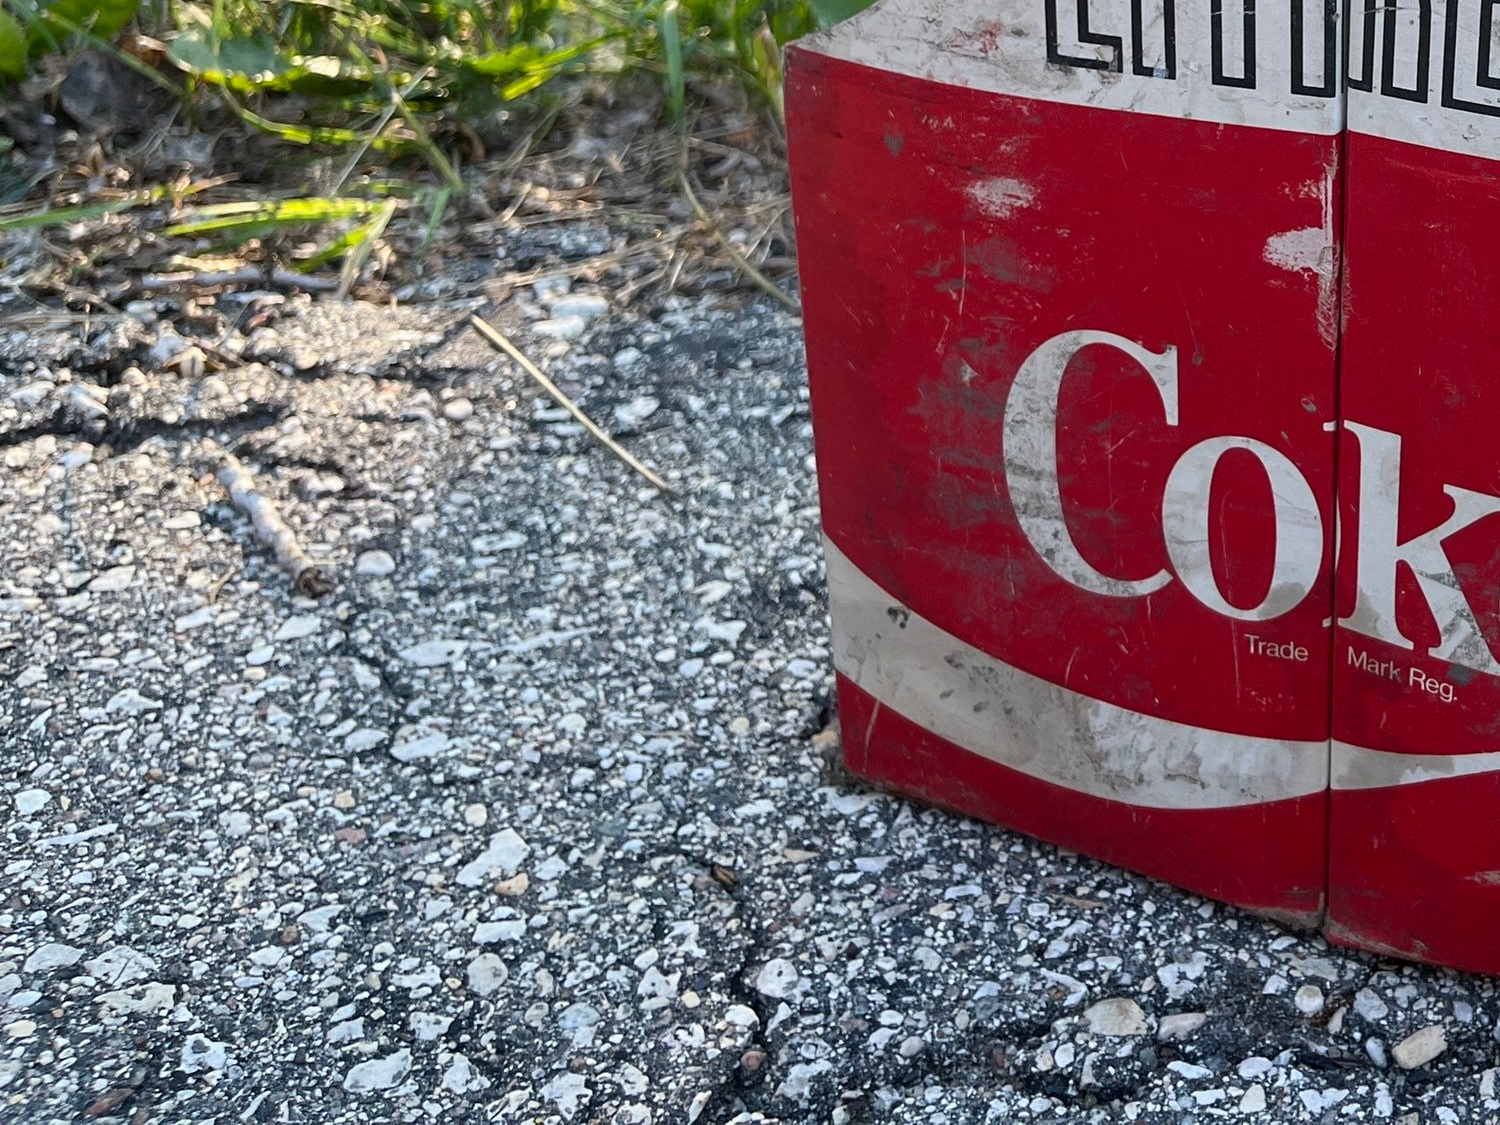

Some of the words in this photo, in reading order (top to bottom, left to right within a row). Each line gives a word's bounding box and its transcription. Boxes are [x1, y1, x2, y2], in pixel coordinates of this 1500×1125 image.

[1244, 633, 1310, 663] Trade
[1347, 645, 1403, 683] Mark
[1408, 666, 1459, 703] Reg.
